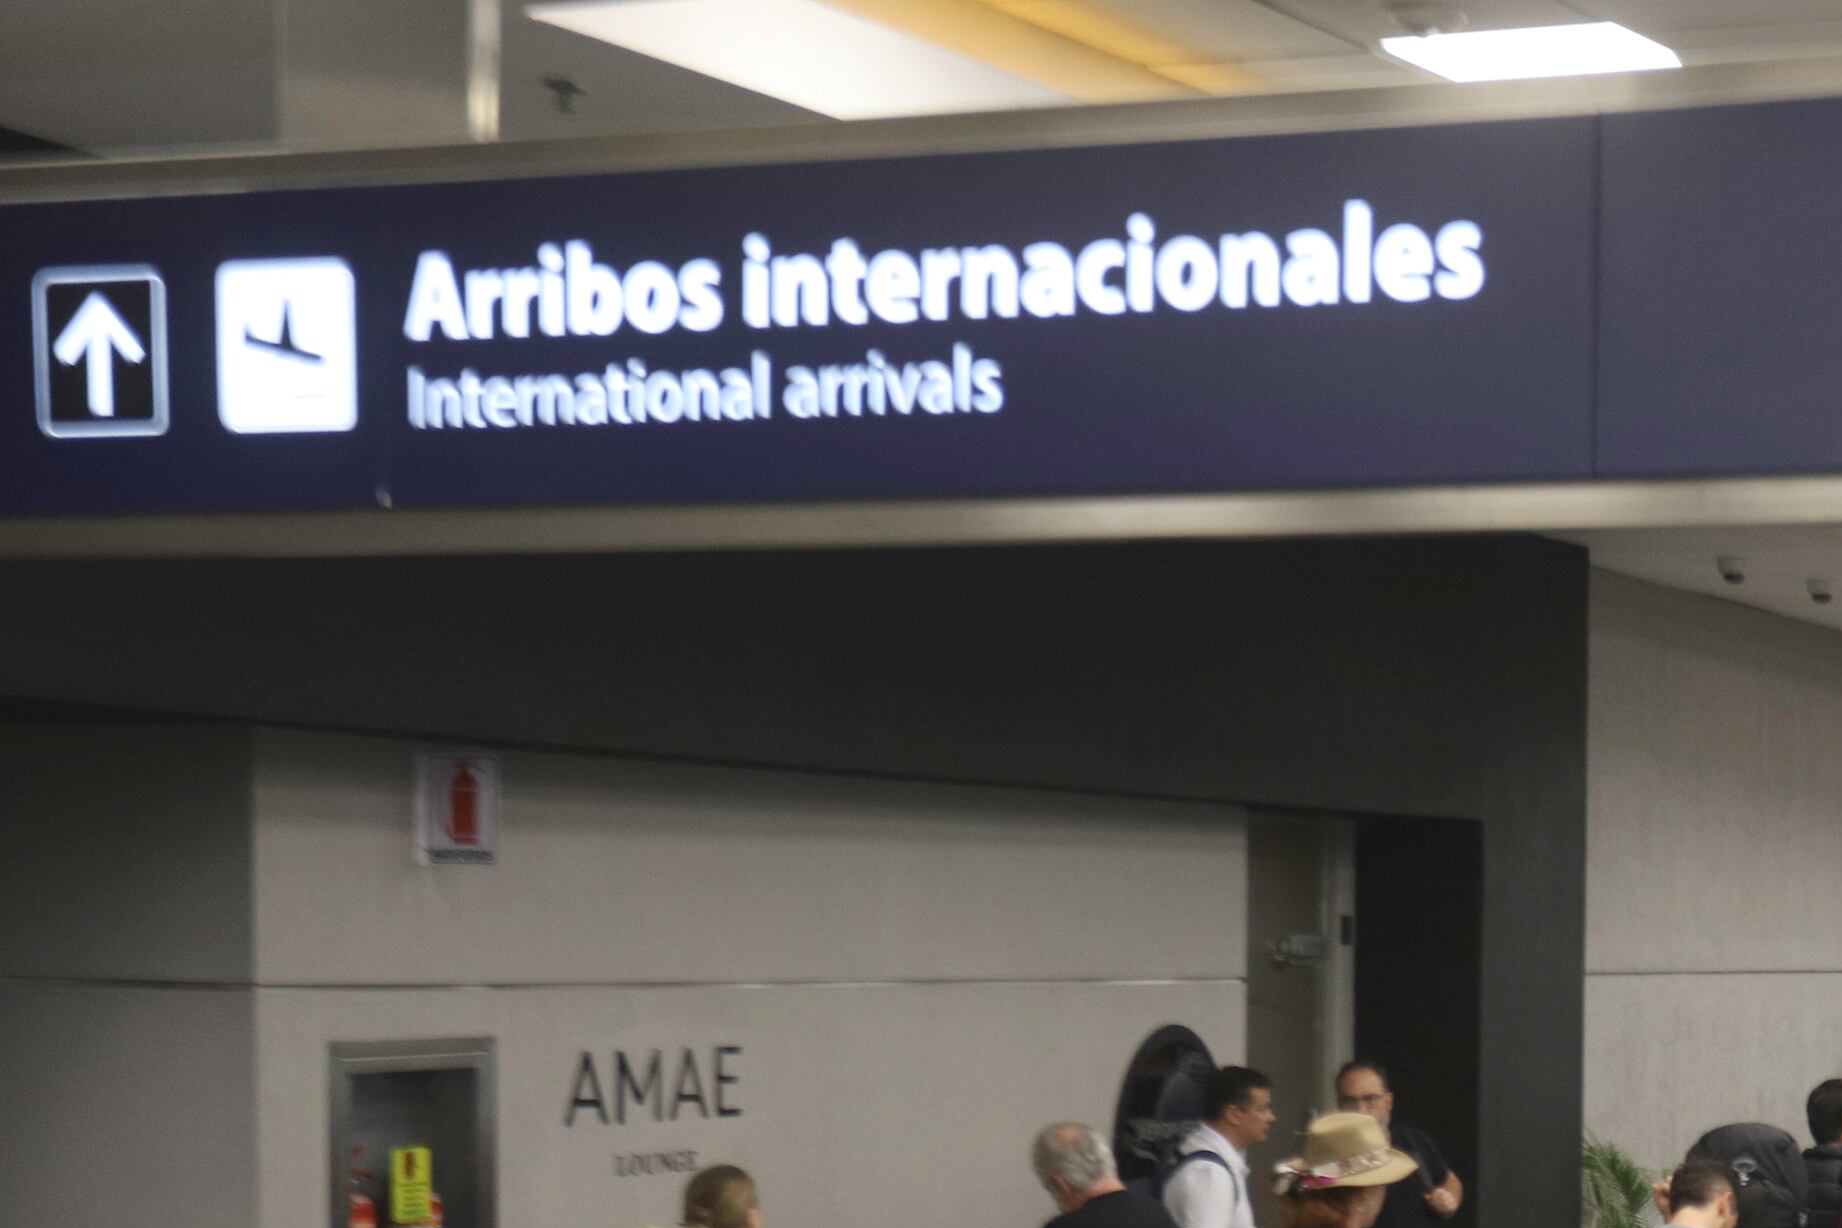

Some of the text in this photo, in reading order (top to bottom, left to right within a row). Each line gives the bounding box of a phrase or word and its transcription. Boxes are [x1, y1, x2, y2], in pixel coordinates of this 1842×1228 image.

[403, 198, 1487, 342] Arribos internacionales
[406, 341, 1004, 430] International arrivals
[562, 1045, 744, 1128] AMAE
